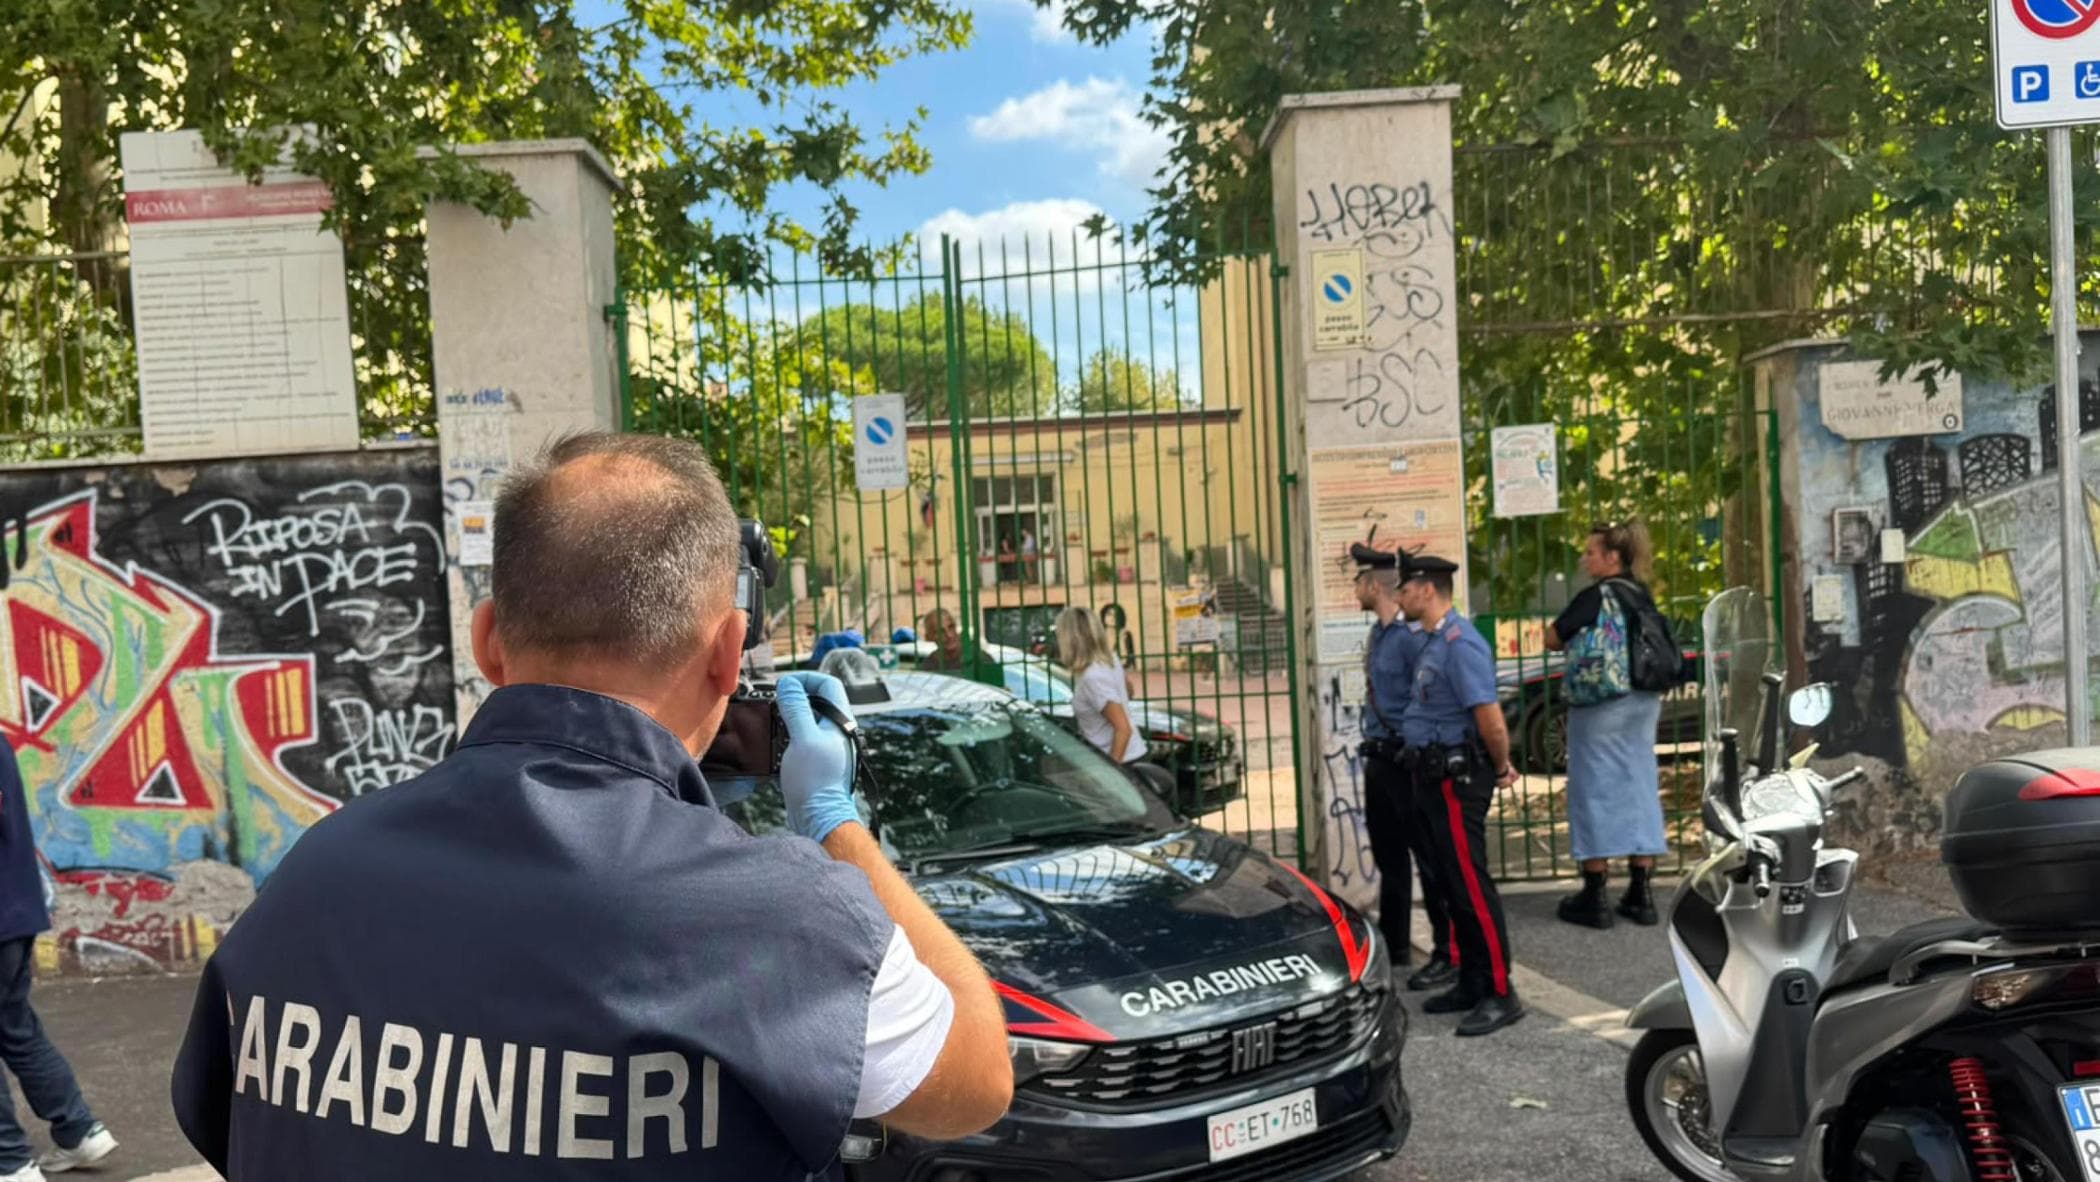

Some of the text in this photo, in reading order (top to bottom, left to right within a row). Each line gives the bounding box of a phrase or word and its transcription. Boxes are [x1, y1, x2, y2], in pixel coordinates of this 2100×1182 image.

[2020, 71, 2042, 100] P
[132, 201, 188, 217] ROMA
[182, 498, 378, 566] RIPOSA
[227, 543, 417, 637] IN PACE
[1120, 953, 1322, 1017] CARABINIERI
[227, 991, 720, 1160] ARABINIERI
[1231, 1021, 1278, 1075] FIAT
[1212, 1099, 1313, 1151] CC ET 768
